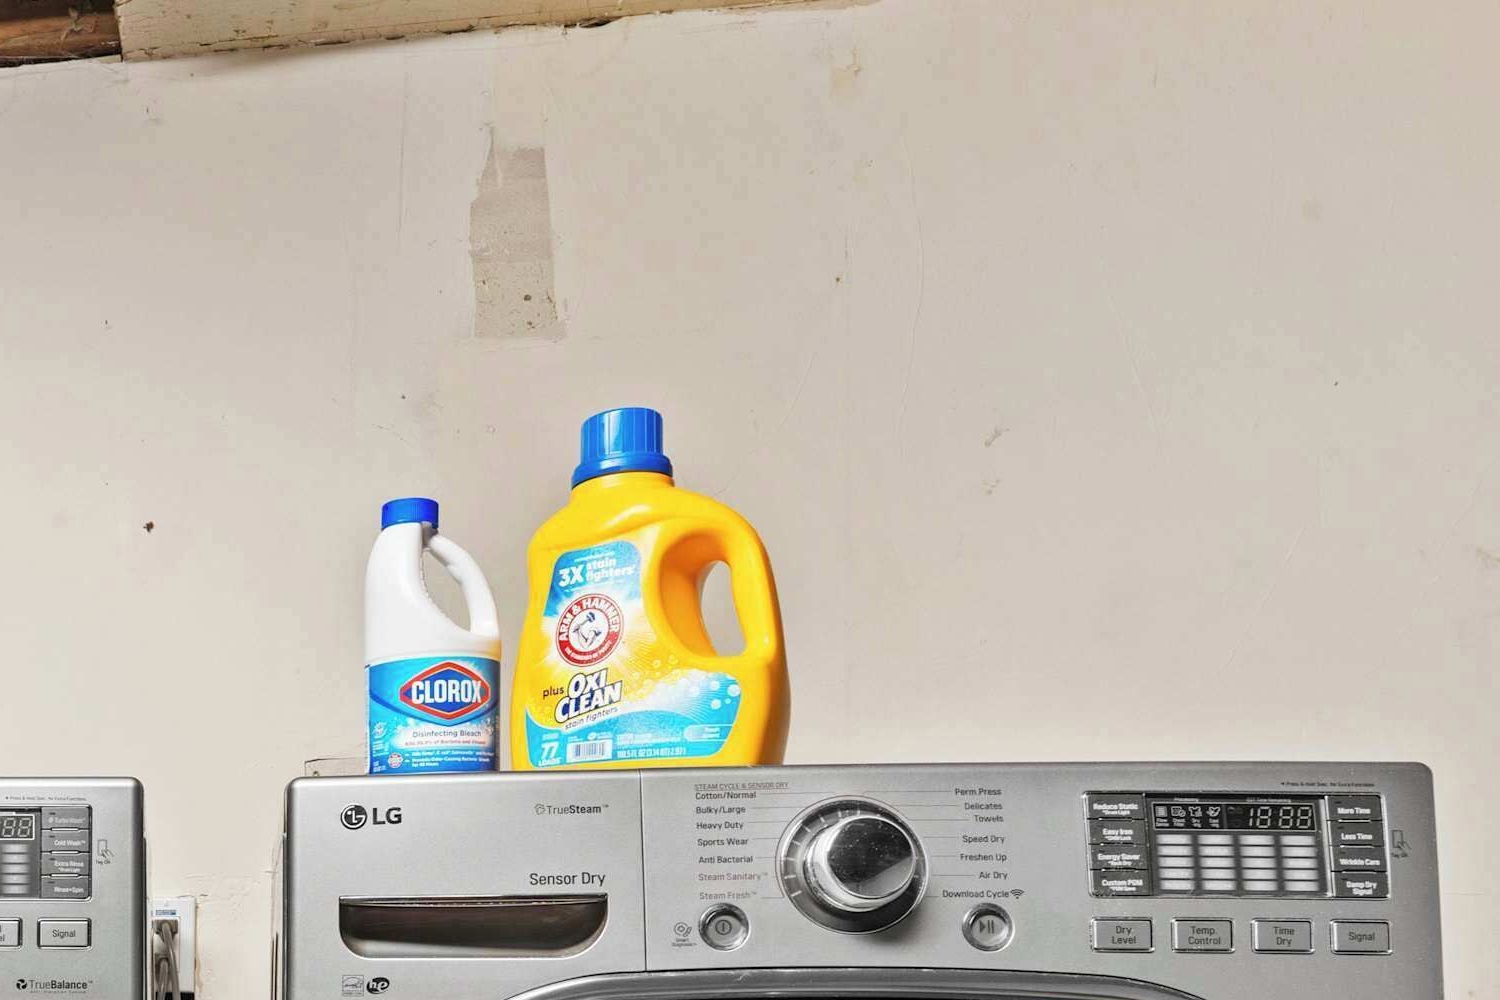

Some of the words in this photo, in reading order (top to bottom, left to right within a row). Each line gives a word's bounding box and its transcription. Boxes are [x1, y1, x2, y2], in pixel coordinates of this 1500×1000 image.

[558, 564, 585, 587] 3X
[558, 614, 573, 640] ARM
[582, 598, 620, 632] HAMMER
[542, 686, 564, 700] plus
[567, 668, 608, 698] OXI
[411, 680, 482, 704] CLOROX
[554, 680, 623, 724] CLEAN
[412, 730, 458, 738] Disinfecting
[541, 742, 559, 760] 77
[695, 792, 756, 800] Cotton/Normal
[978, 788, 1002, 796] Press
[546, 804, 602, 815] TrueSteam
[696, 806, 746, 814] Bulky/Large
[964, 802, 1003, 810] Delicates
[372, 807, 402, 824] LG
[974, 814, 1004, 822] Towels
[696, 822, 722, 830] Heavy
[724, 822, 744, 830] Duty
[697, 838, 725, 848] Sports
[727, 838, 749, 846] Wear
[962, 835, 988, 844] Speed
[990, 835, 1005, 844] Dry
[698, 856, 715, 864] Anti
[996, 854, 1008, 862] Up
[529, 872, 578, 886] Sensor
[581, 872, 606, 887] Dry
[727, 872, 762, 881] Sanitary
[993, 872, 1008, 880] Dry
[699, 892, 726, 900] Steam
[727, 892, 750, 900] Fresh
[942, 890, 984, 898] Download
[986, 890, 1010, 899] Cycle
[52, 929, 76, 940] Signal
[1116, 926, 1132, 936] Dry
[1273, 926, 1295, 936] Time
[1112, 936, 1137, 946] Level
[1188, 936, 1222, 946] Control
[1276, 936, 1292, 947] Dry
[1349, 931, 1376, 942] Signal
[28, 980, 88, 990] TrueBalance
